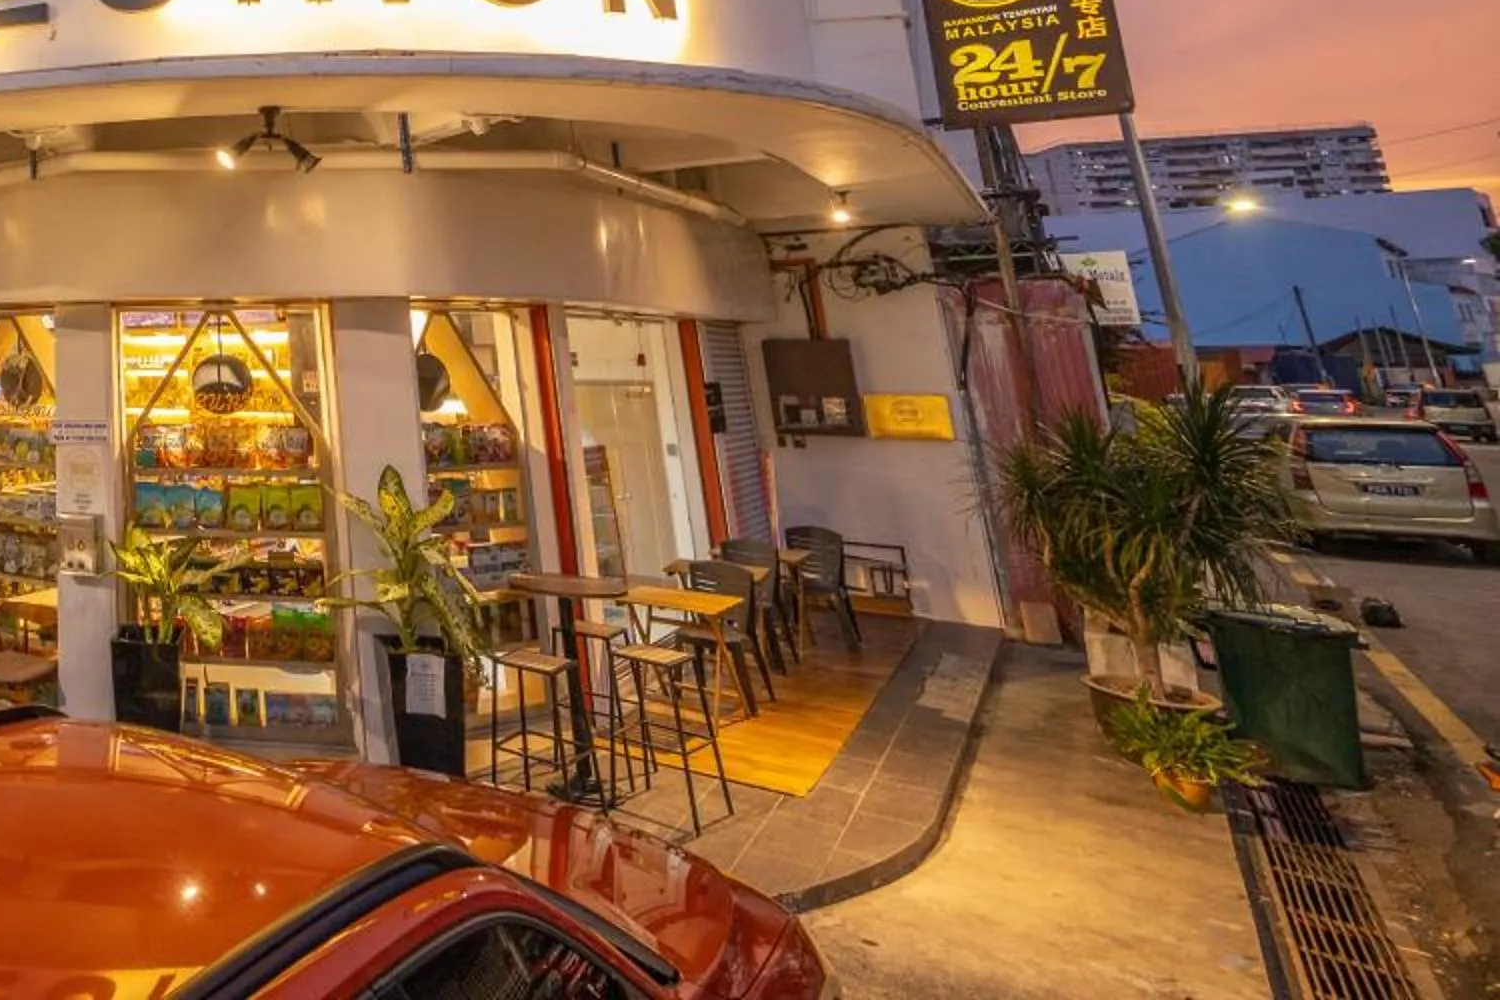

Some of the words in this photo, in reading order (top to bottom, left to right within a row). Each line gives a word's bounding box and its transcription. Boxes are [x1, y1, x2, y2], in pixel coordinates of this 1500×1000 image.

[945, 13, 1061, 41] MALAYSIA
[949, 31, 1107, 93] 24/7
[956, 80, 1040, 102] hour
[956, 94, 1053, 112] Convenient
[1057, 87, 1108, 103] Store
